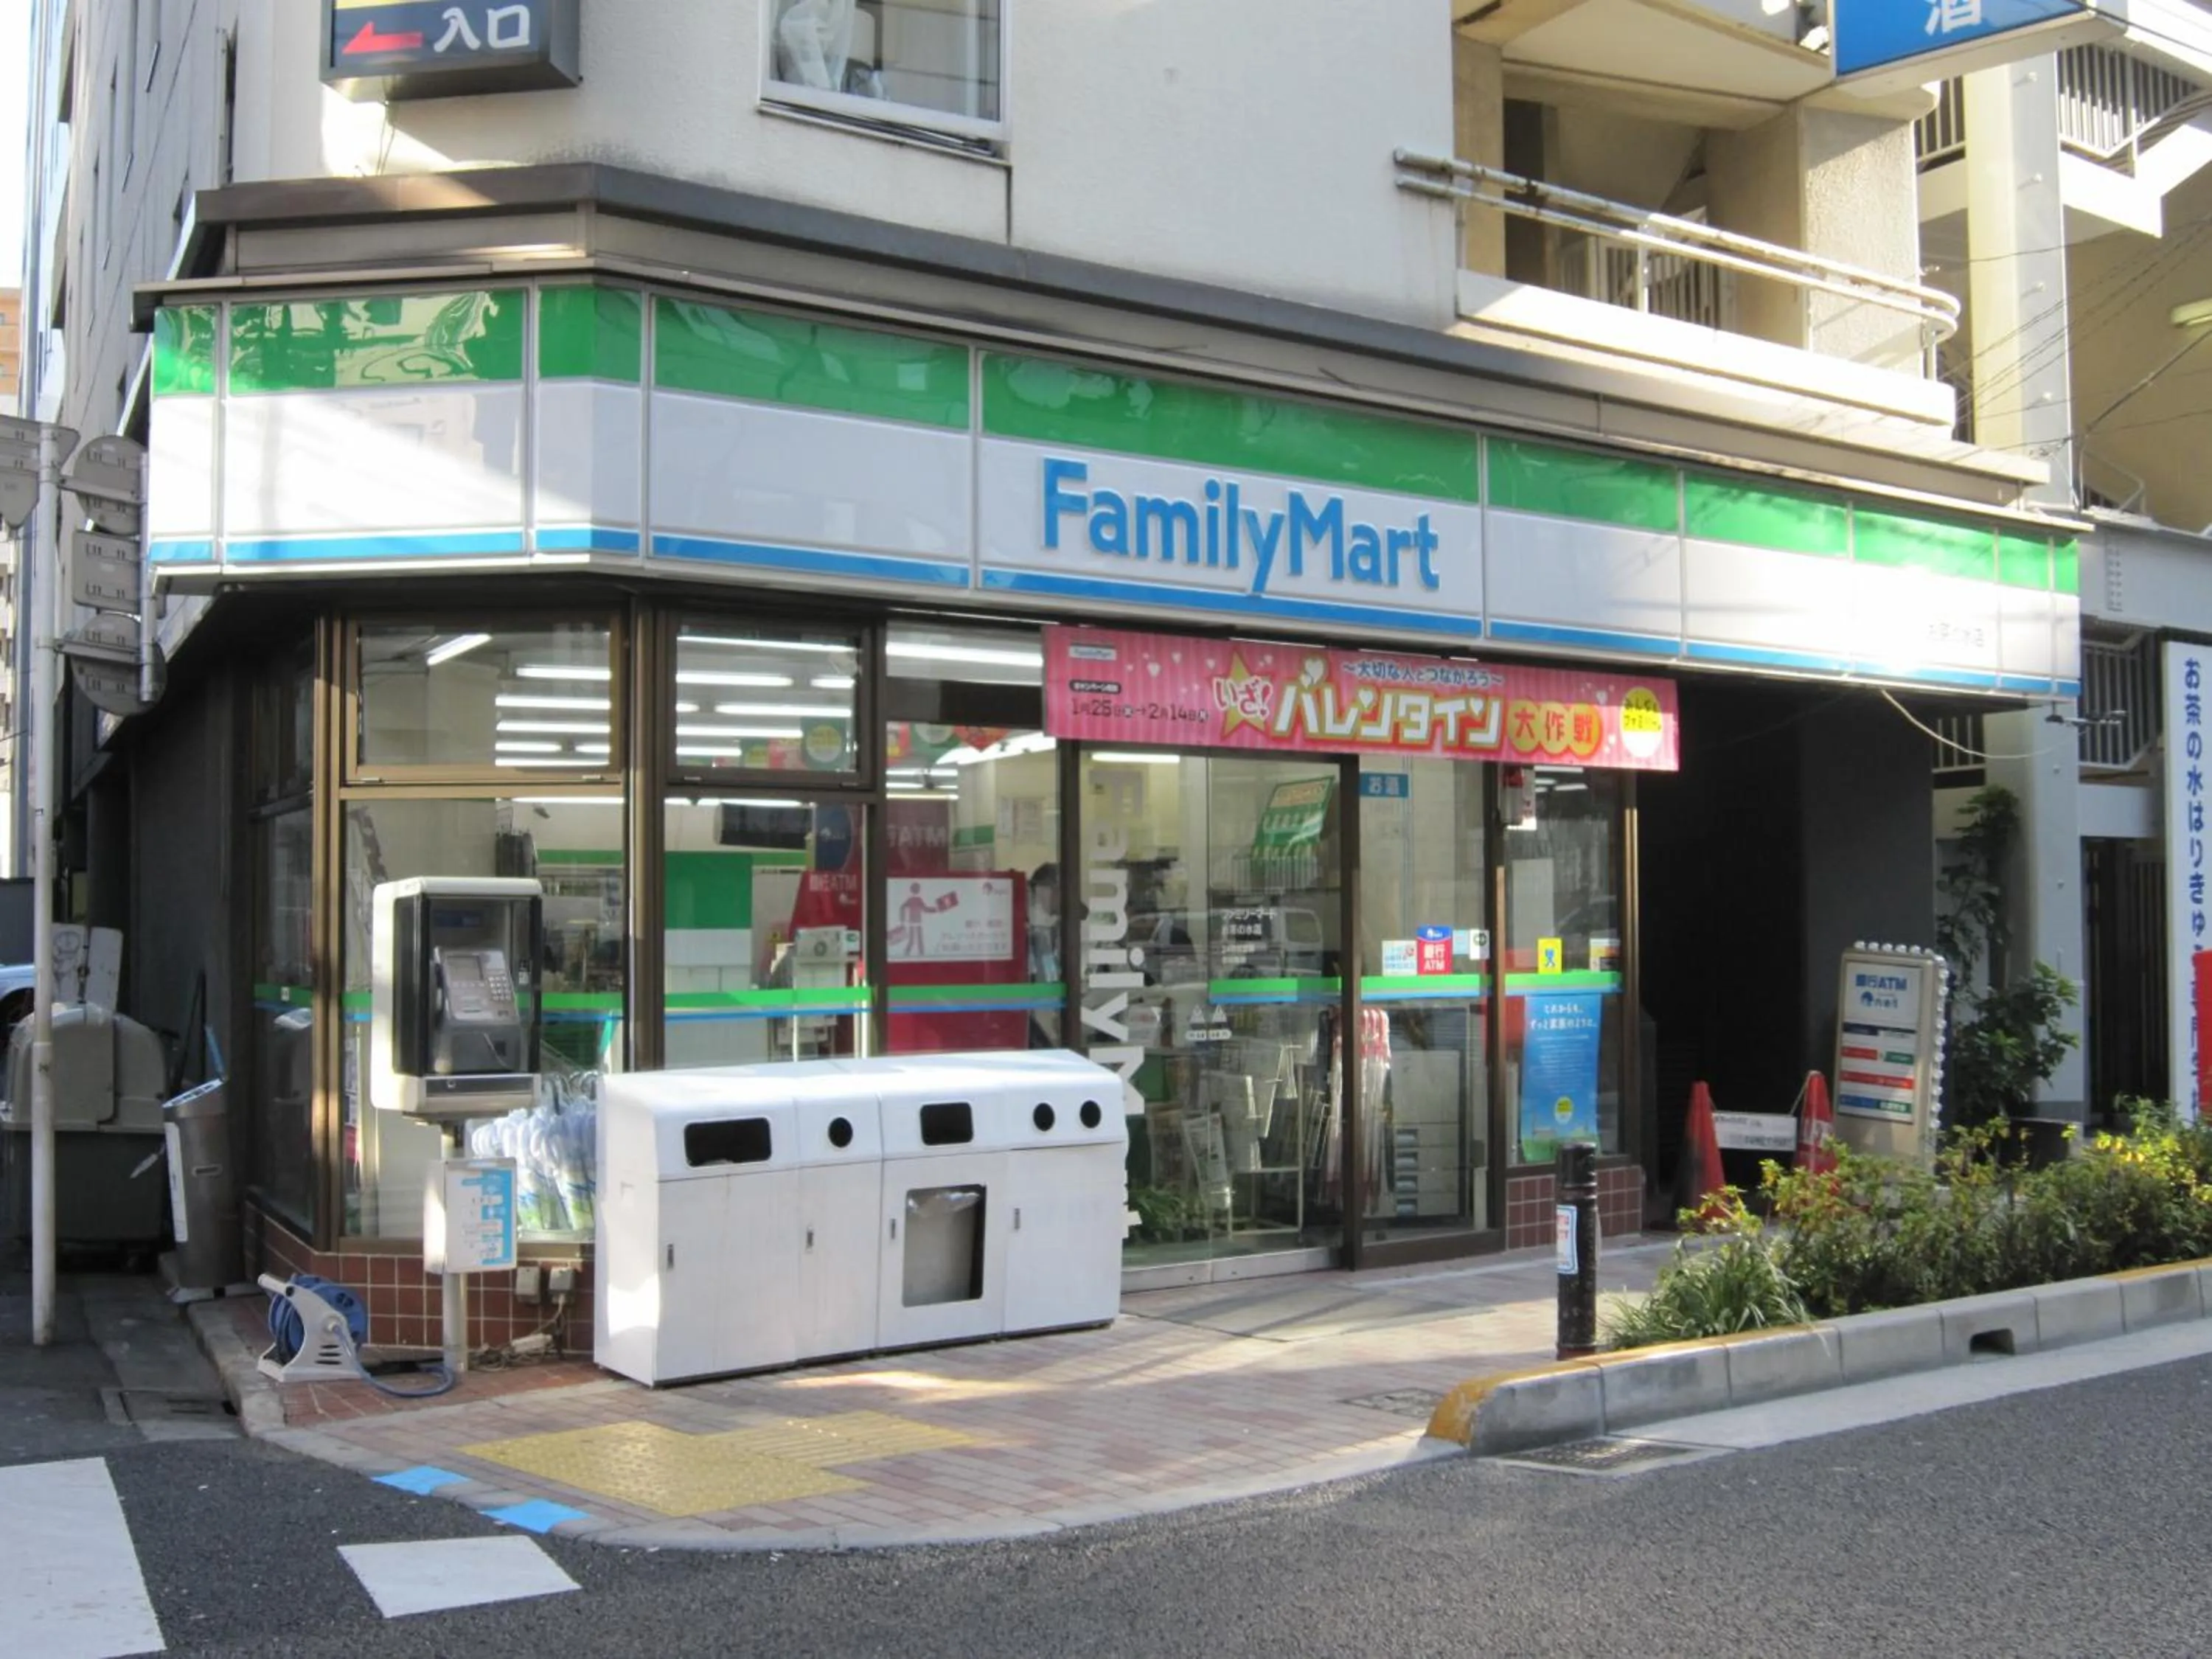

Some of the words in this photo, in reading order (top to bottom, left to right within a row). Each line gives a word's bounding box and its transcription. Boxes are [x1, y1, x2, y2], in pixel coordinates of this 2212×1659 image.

[434, 4, 530, 52] 入口
[1043, 456, 1440, 594] FamilyMart
[1514, 708, 1593, 744] 大作戦
